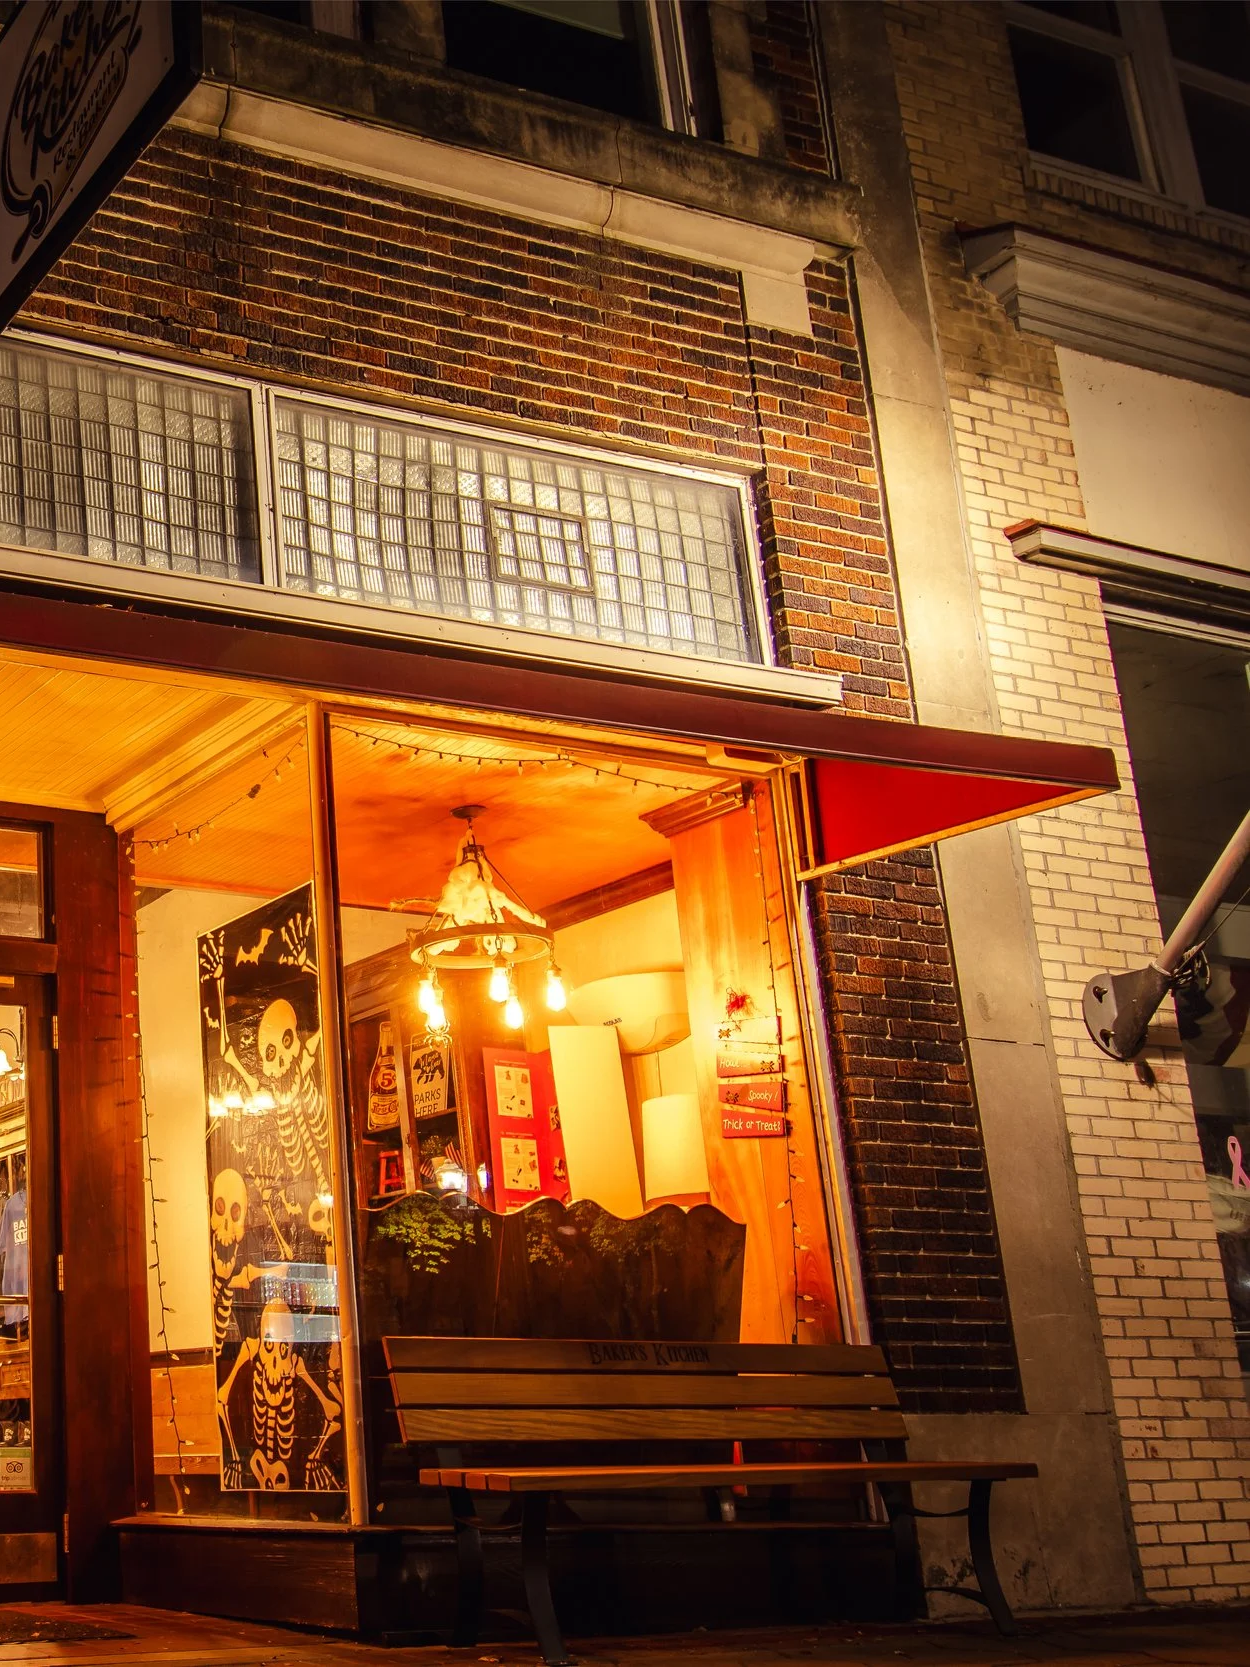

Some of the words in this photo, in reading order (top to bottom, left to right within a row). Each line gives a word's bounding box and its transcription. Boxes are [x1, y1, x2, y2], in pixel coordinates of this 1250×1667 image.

[53, 51, 116, 173] Restaurant
[414, 1088, 441, 1105] PARKS
[414, 1103, 439, 1117] HERE
[723, 1118, 743, 1130] Trick
[746, 1119, 753, 1129] or
[586, 1342, 648, 1365] BAKER'S
[651, 1342, 710, 1366] KITCHEN
